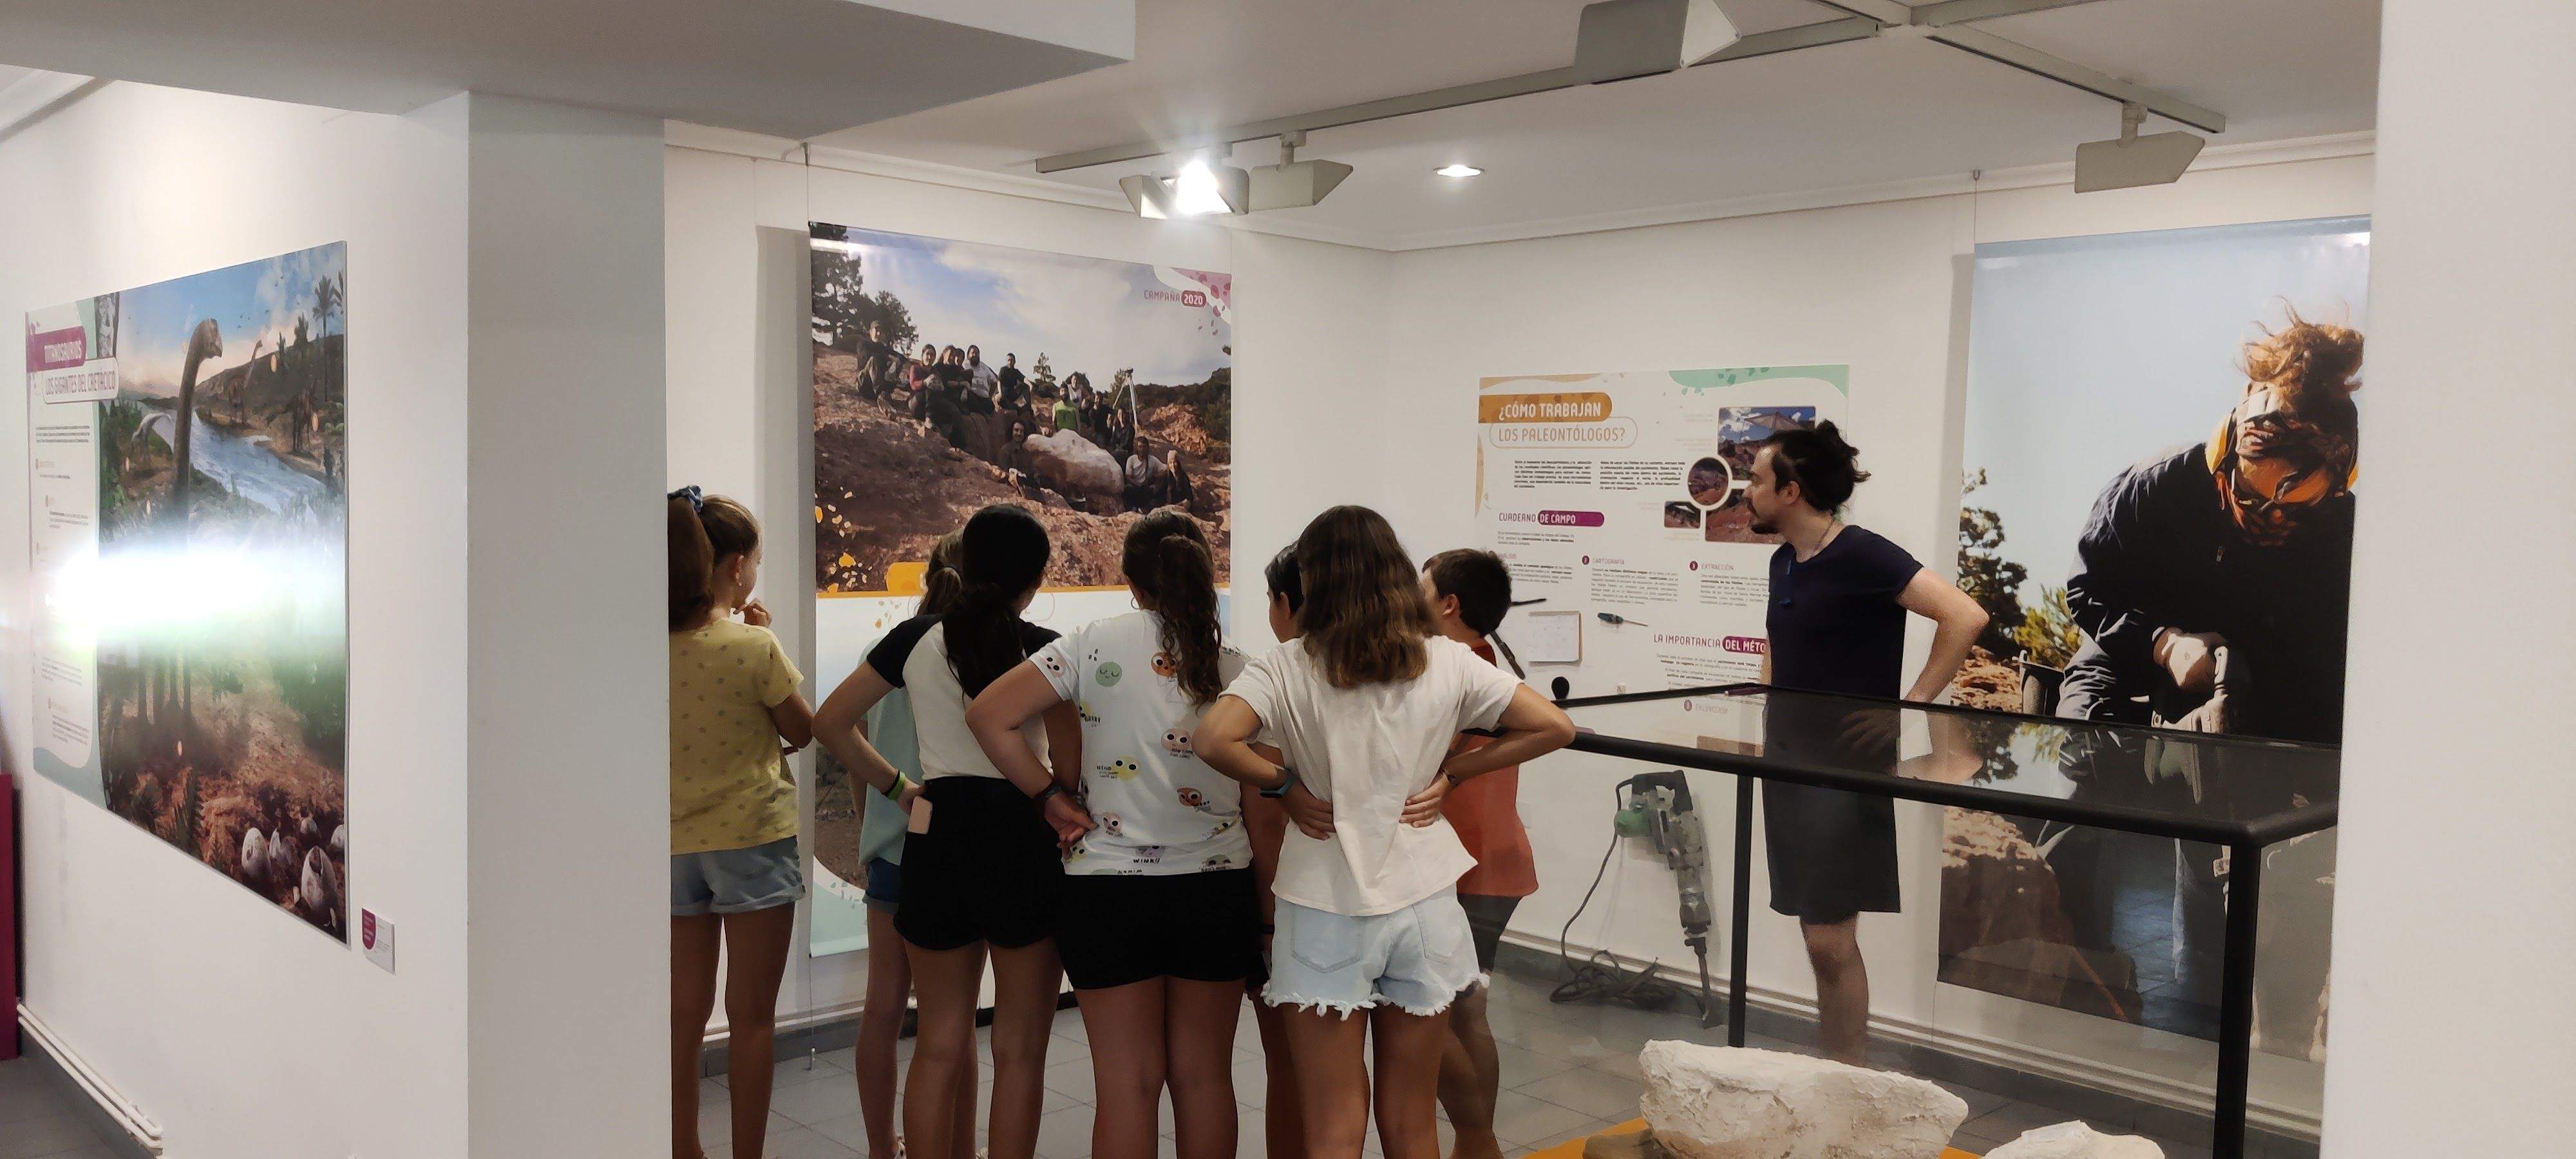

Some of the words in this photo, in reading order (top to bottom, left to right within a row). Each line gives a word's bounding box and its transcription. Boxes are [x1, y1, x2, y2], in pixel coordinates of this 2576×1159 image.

[1184, 294, 1203, 305] 2020
[1499, 400, 1536, 421] ¿CÓMO
[1540, 402, 1601, 418] TRABAJAN
[1499, 428, 1518, 442] LOS
[1522, 425, 1625, 442] PALEONTÓLOGOS?
[1499, 513, 1536, 523] CUADERNO
[1540, 513, 1549, 523] DE
[1551, 514, 1576, 524] CAMPO
[1654, 634, 1663, 643] LA
[1665, 634, 1721, 648] IMPORTANCIA
[1725, 639, 1741, 651] DEL
